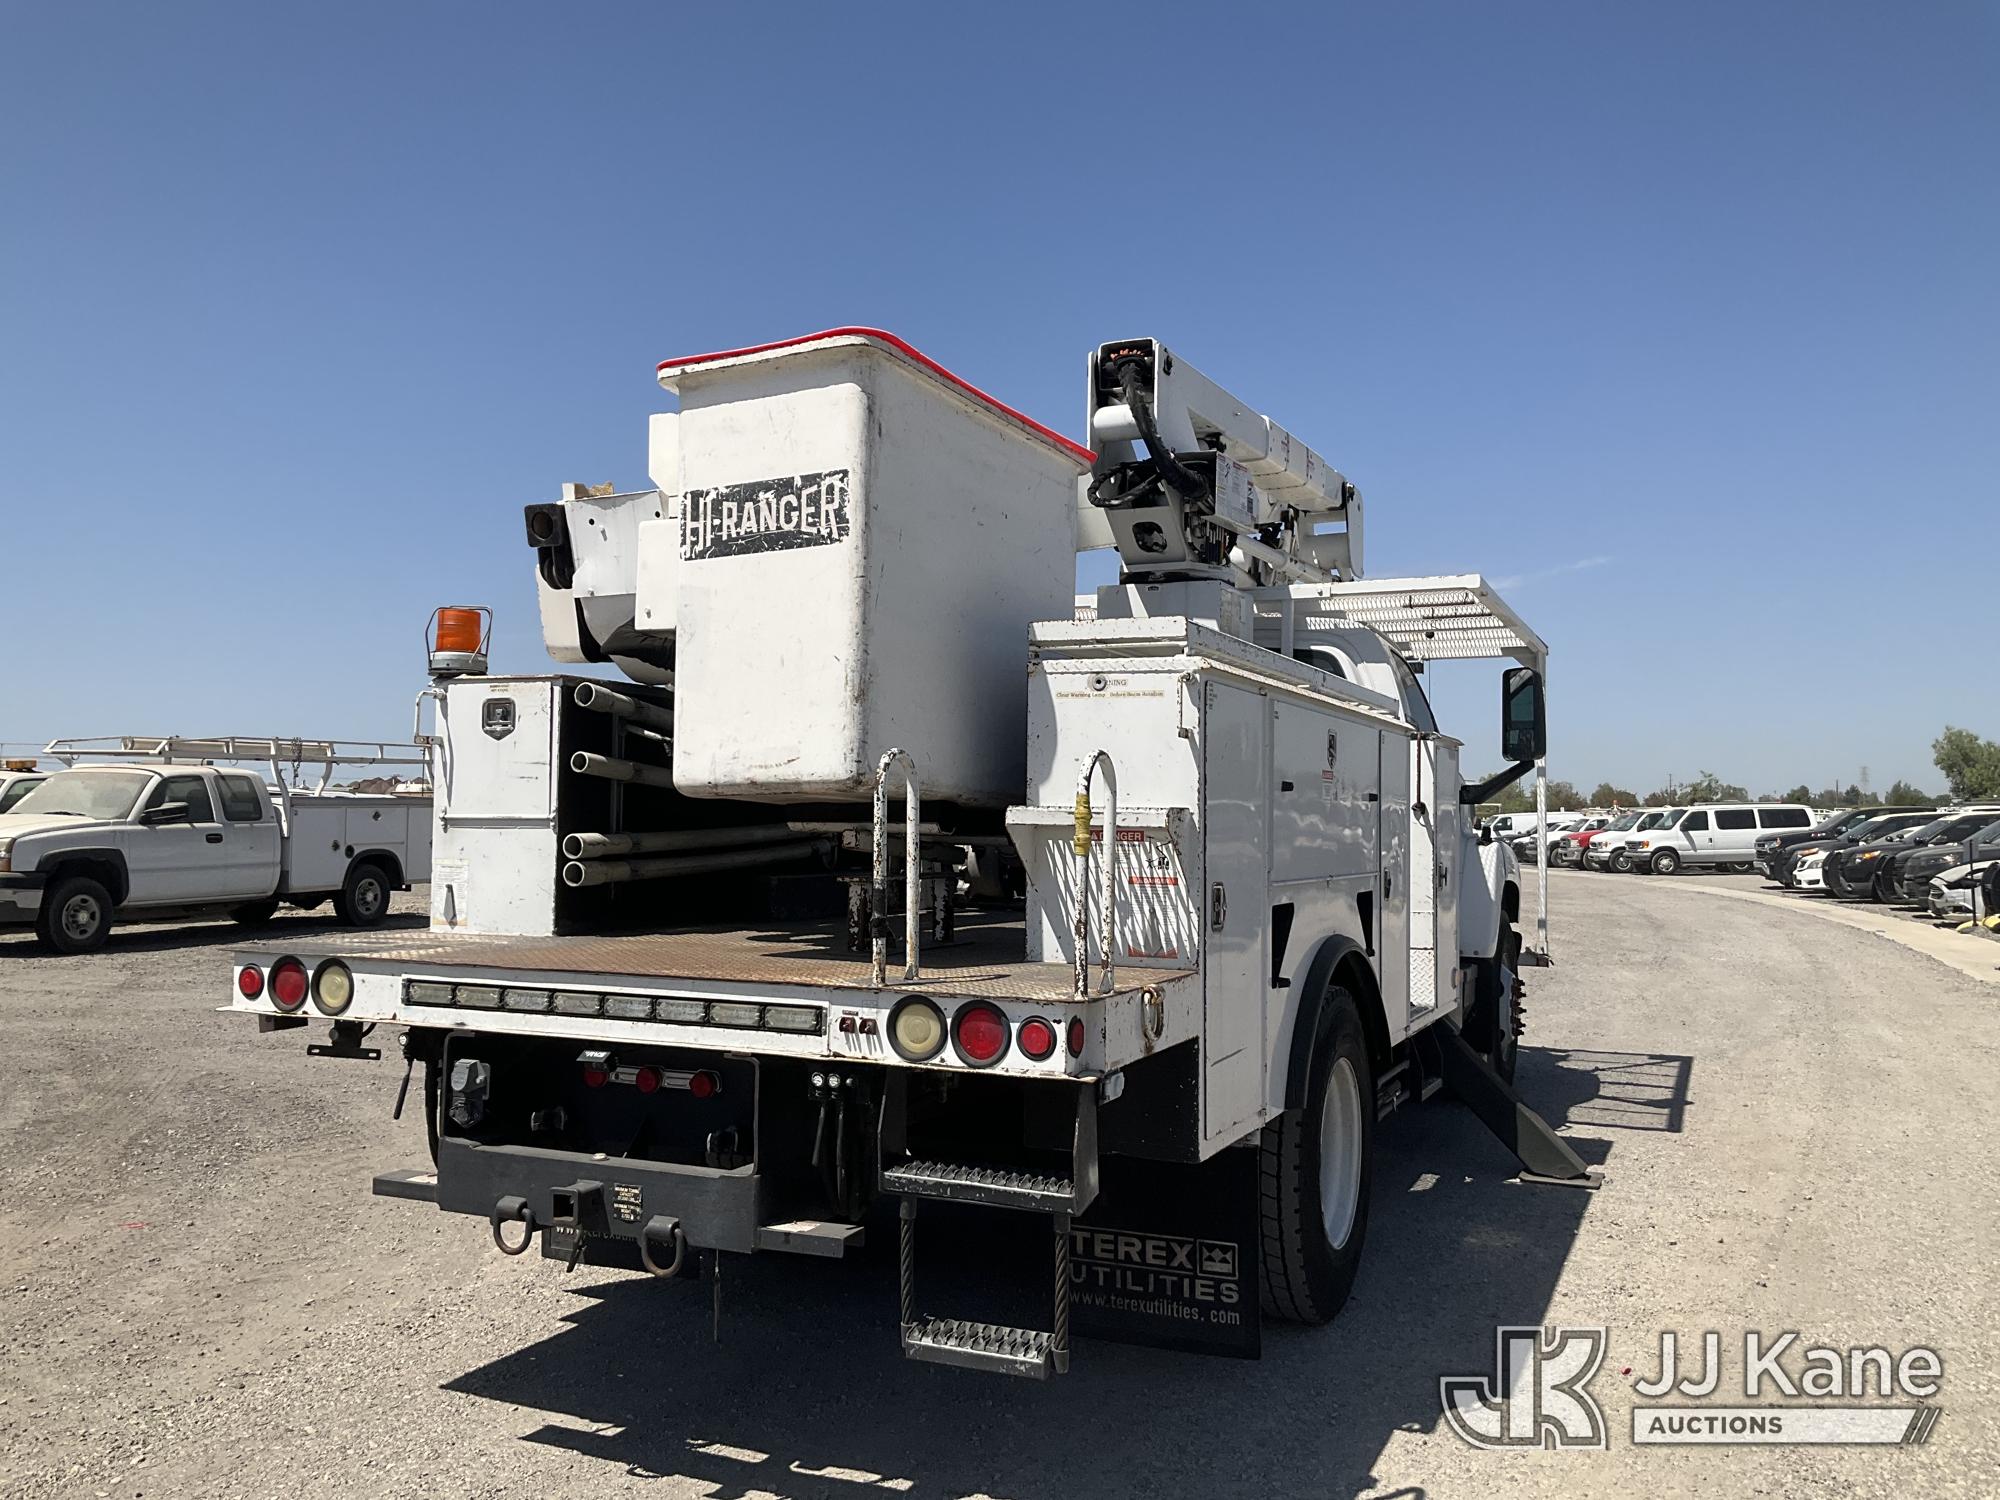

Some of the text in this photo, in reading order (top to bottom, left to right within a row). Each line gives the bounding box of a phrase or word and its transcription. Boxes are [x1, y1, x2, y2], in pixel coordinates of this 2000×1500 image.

[1100, 831, 1141, 841] DNGER
[1070, 1231, 1193, 1269] TEREX
[1069, 1263, 1240, 1304] UTILITIES
